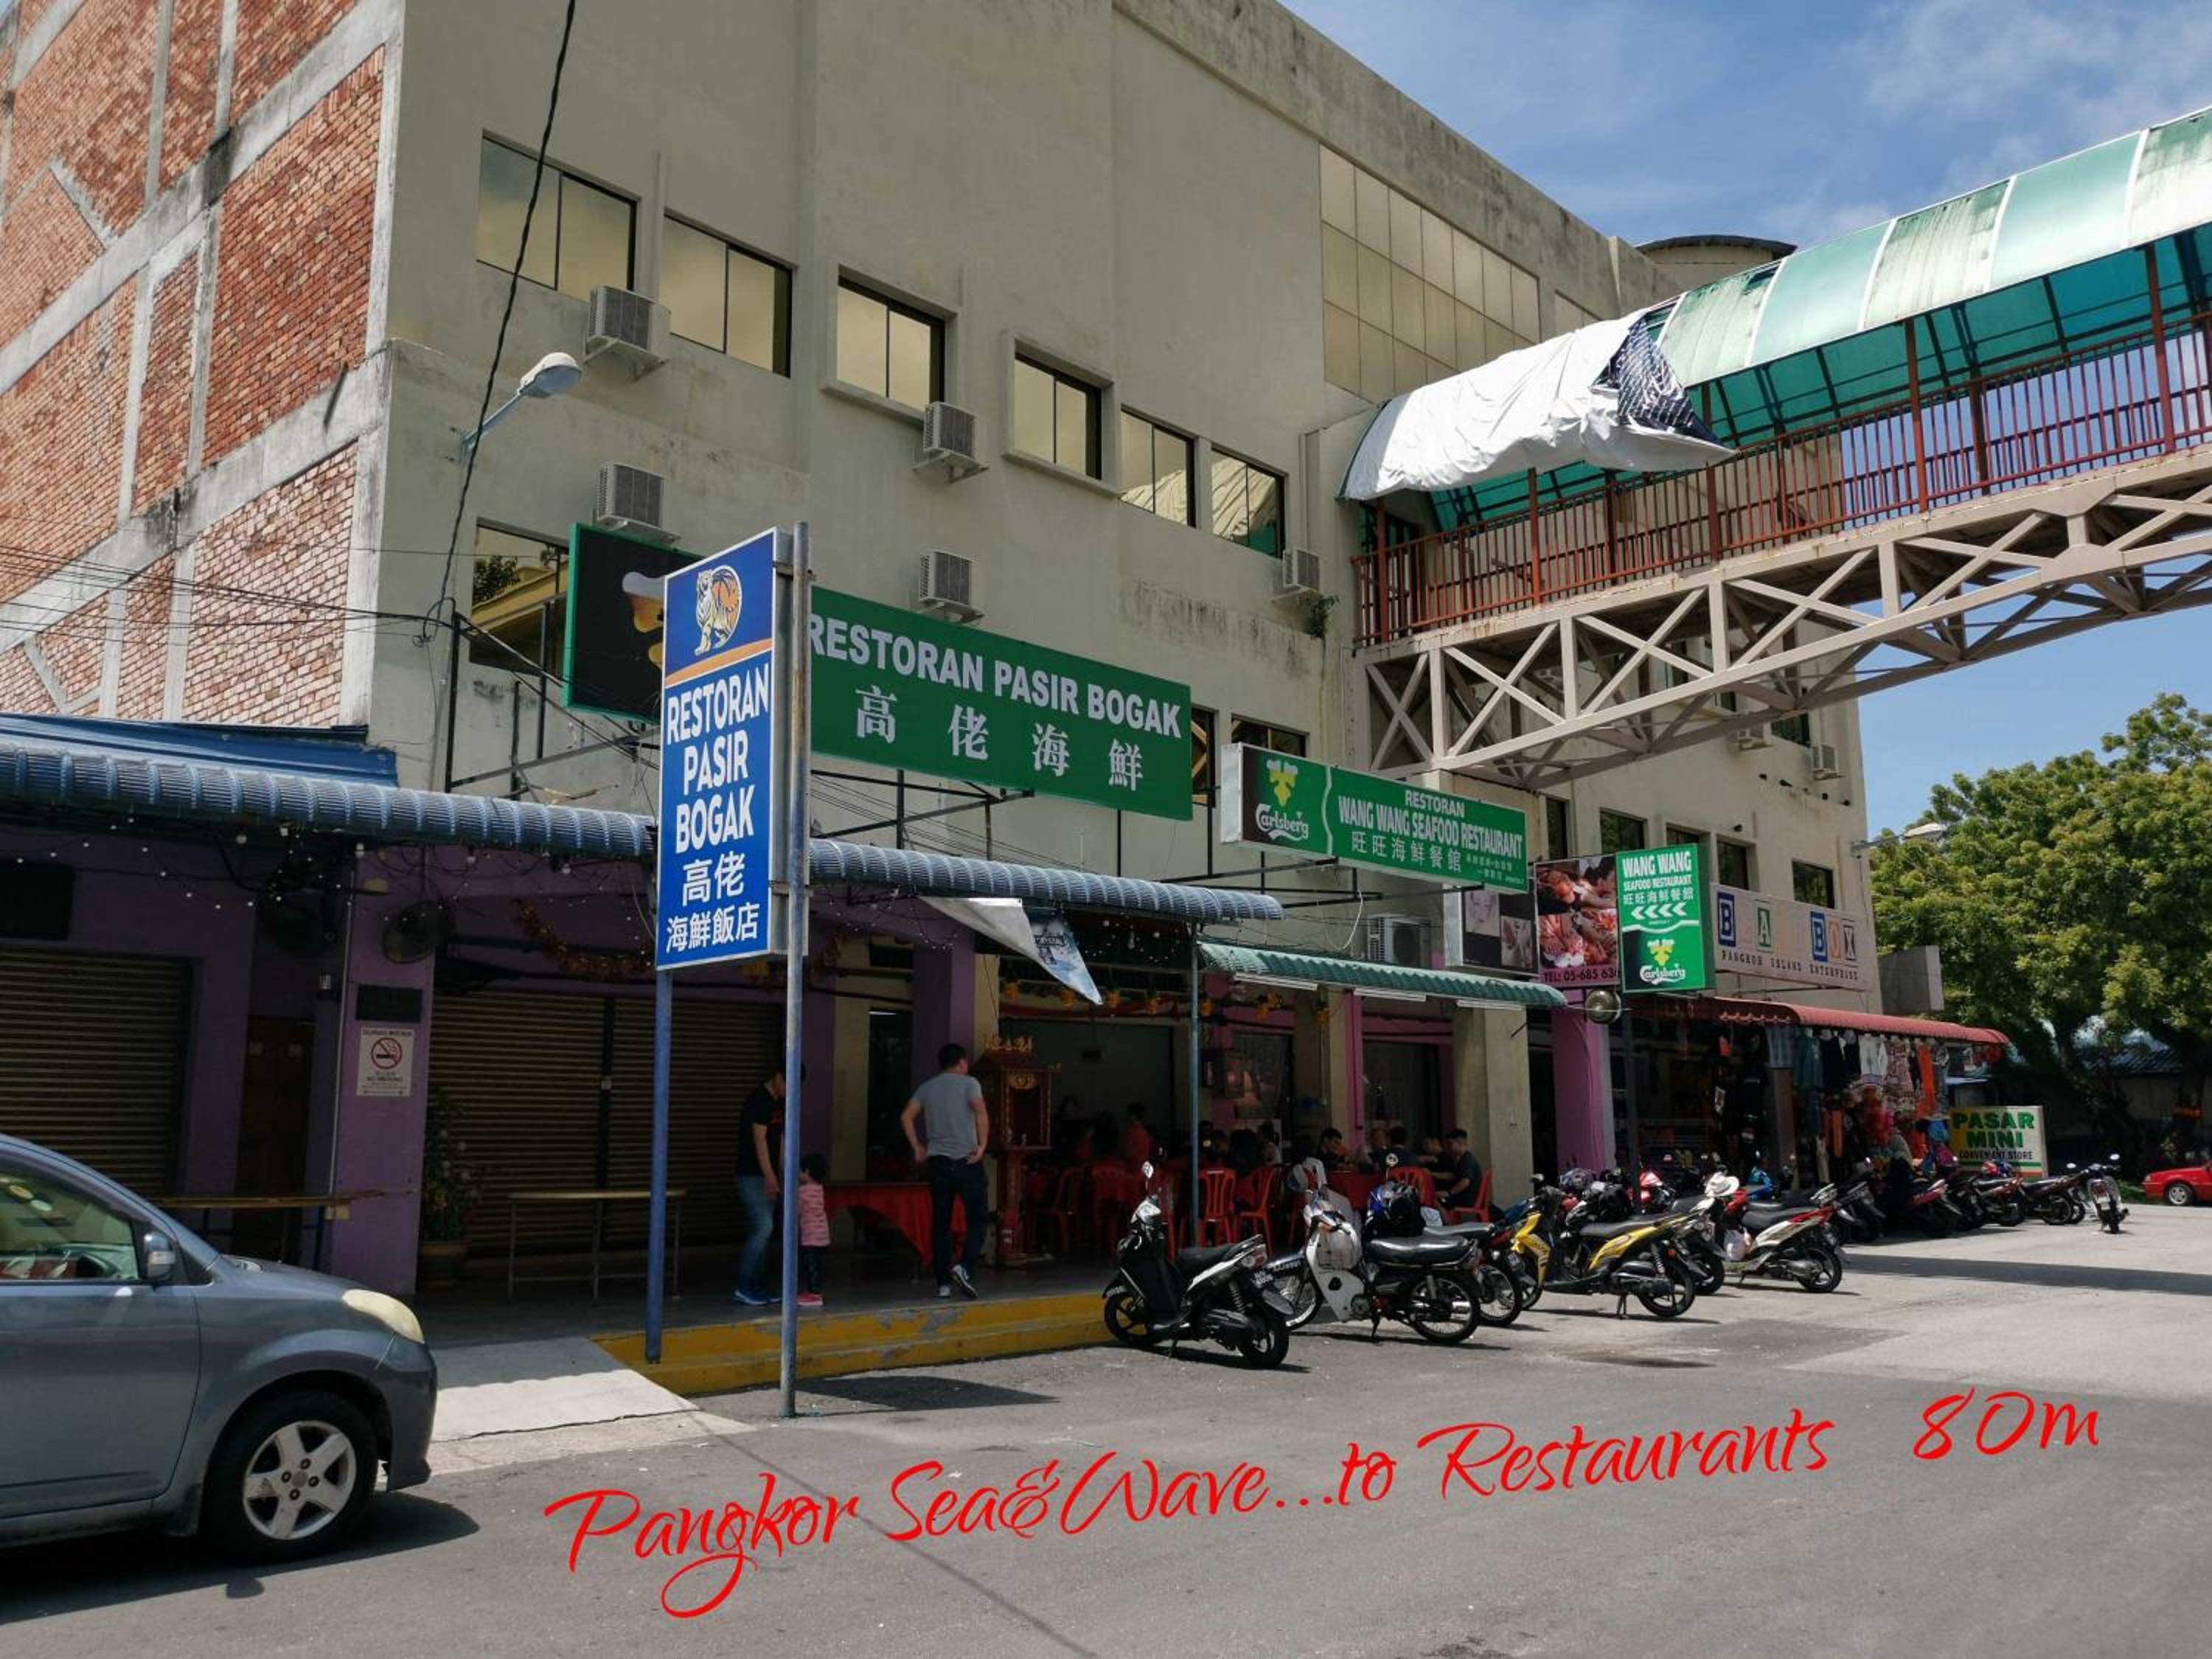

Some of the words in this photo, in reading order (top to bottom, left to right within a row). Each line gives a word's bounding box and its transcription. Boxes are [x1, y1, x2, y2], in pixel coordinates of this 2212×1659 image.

[809, 613, 983, 693] RESTORAN
[995, 660, 1079, 714] PASIR
[1088, 684, 1182, 738] BOGAK
[667, 664, 769, 745] RESTORAN
[855, 684, 1143, 791] 高佬海鮮
[684, 730, 748, 796] PASIR
[675, 785, 755, 855] BOGAK
[1256, 803, 1310, 841] Carlsberg
[1405, 790, 1465, 818] RESTORAN
[1338, 796, 1374, 830] WANG
[1376, 803, 1410, 836] WANG
[1412, 812, 1459, 847] SEAFOOD
[1461, 821, 1523, 860] RESTAURANT
[681, 850, 745, 907] 高佬
[1622, 855, 1655, 878] WANG
[1657, 851, 1692, 874] WANG
[1624, 878, 1652, 891] SEAFOOD
[1652, 874, 1692, 888] RESTAURANT
[666, 902, 760, 953] 海鮮飯店
[1544, 972, 1561, 983] TEL:
[1563, 968, 1599, 981] 05-685
[1639, 963, 1686, 984] Carlsberg
[1952, 1110, 2035, 1130] PASAR
[1966, 1131, 2024, 1149] MINI
[2007, 1150, 2034, 1160] STORE
